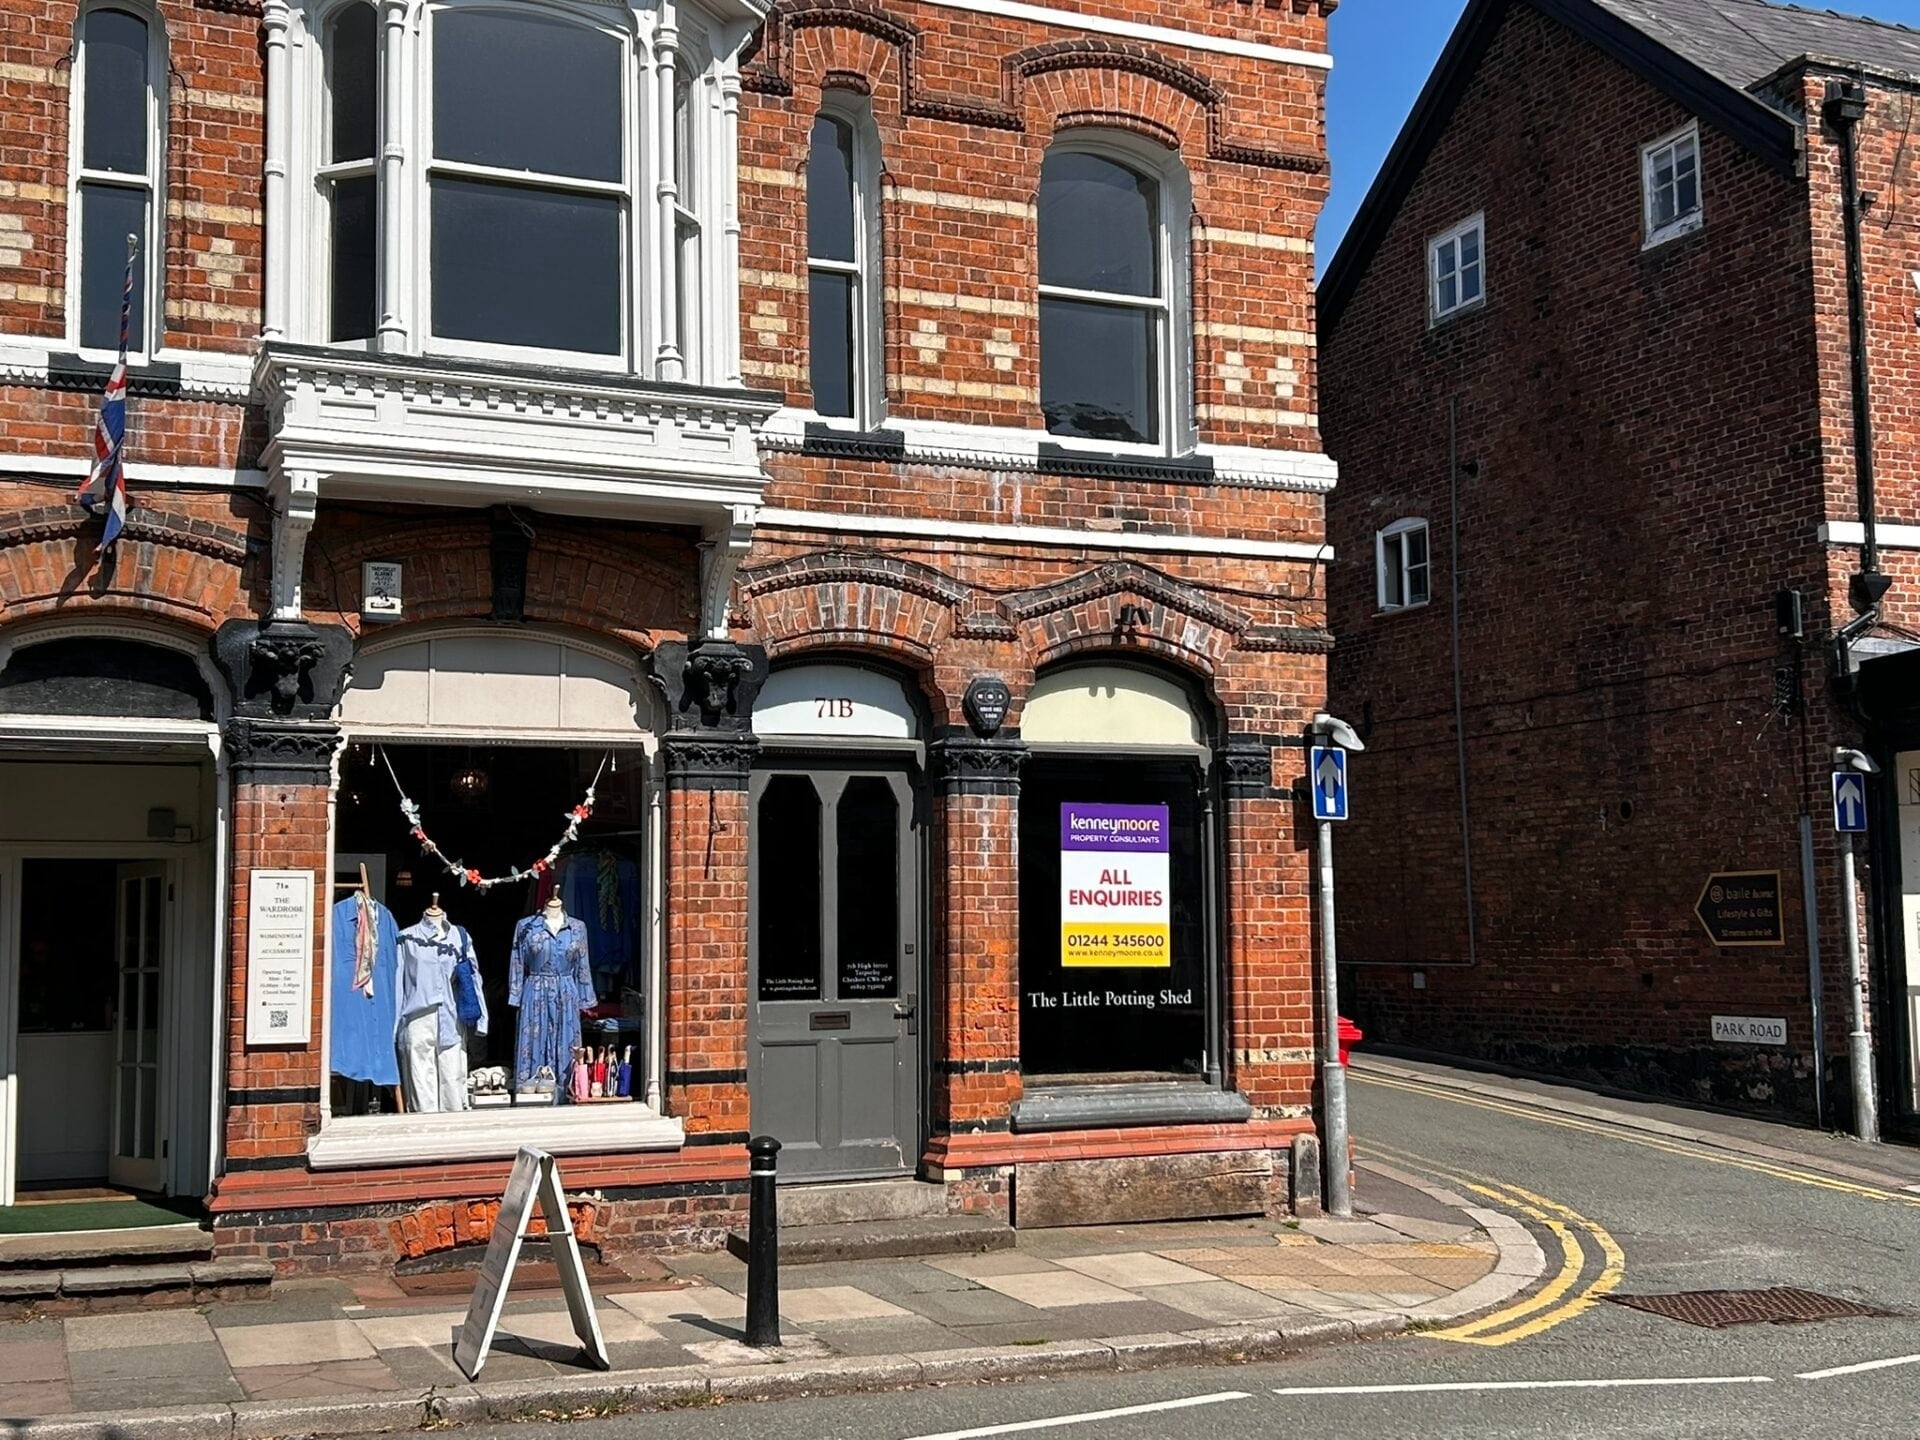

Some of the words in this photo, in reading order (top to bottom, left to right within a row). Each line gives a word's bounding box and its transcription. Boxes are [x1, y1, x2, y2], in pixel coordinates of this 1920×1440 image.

[815, 697, 853, 718] 71B
[1070, 813, 1160, 834] kenneymoore
[1070, 834, 1108, 842] PROPERTY
[1109, 835, 1160, 844] CONSULTANTS
[1100, 869, 1132, 885] ALL
[1069, 889, 1163, 907] ENQUIRIES
[1726, 888, 1750, 899] baile
[259, 905, 304, 913] WARDROBE
[1067, 935, 1108, 947] 01244
[1112, 935, 1164, 947] 345600
[1068, 949, 1163, 957] www.kenneymoore.co.uk
[1027, 992, 1057, 1008] The
[1062, 991, 1100, 1007] Little
[1105, 990, 1155, 1009] Potting
[1160, 989, 1192, 1005] Shed
[1716, 1022, 1746, 1036] PARK
[1750, 1024, 1782, 1037] ROAD
